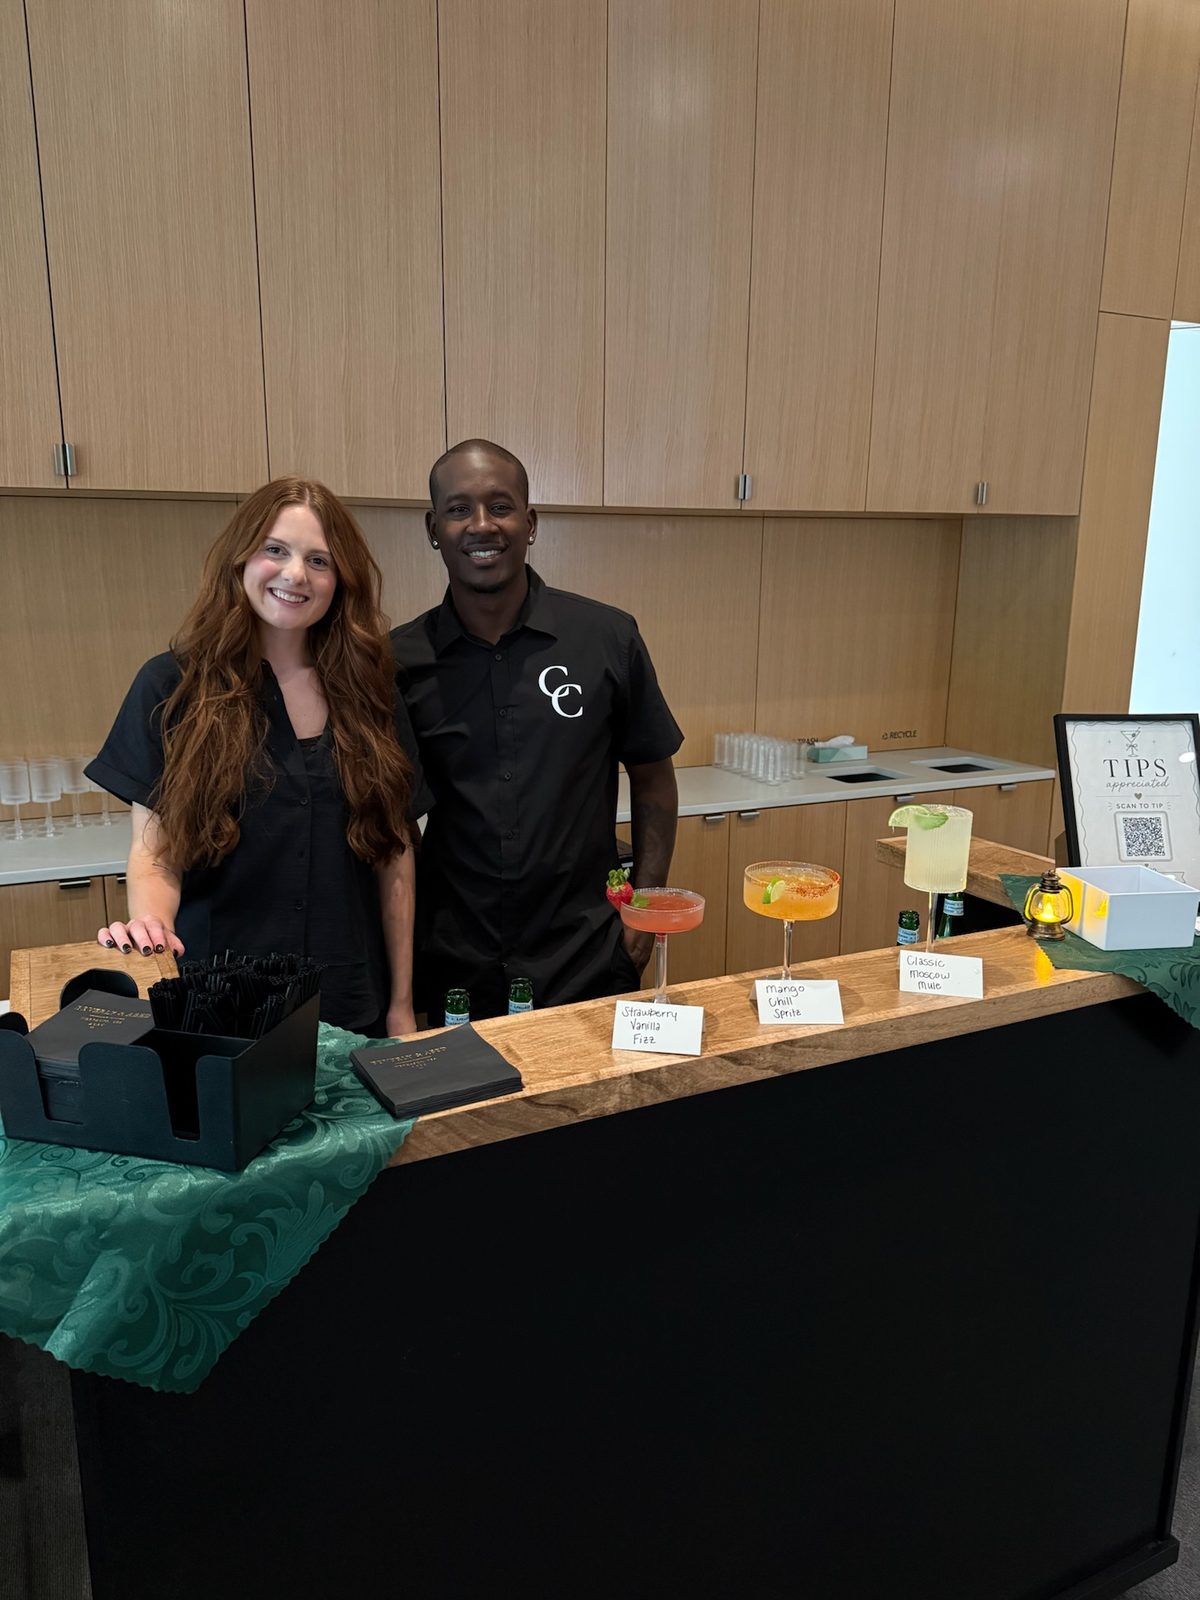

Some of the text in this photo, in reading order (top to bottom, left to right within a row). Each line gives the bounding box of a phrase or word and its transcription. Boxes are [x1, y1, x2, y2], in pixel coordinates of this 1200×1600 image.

[890, 730, 917, 739] RECYCLE
[1103, 758, 1167, 778] TIPS
[1106, 776, 1170, 792] appreciated
[906, 955, 945, 968] Classic
[768, 996, 793, 1008] Chill
[621, 1006, 678, 1022] Strawberry
[773, 1008, 802, 1019] Spritz
[630, 1018, 661, 1031] Vanilla
[633, 1033, 656, 1045] Fizz
